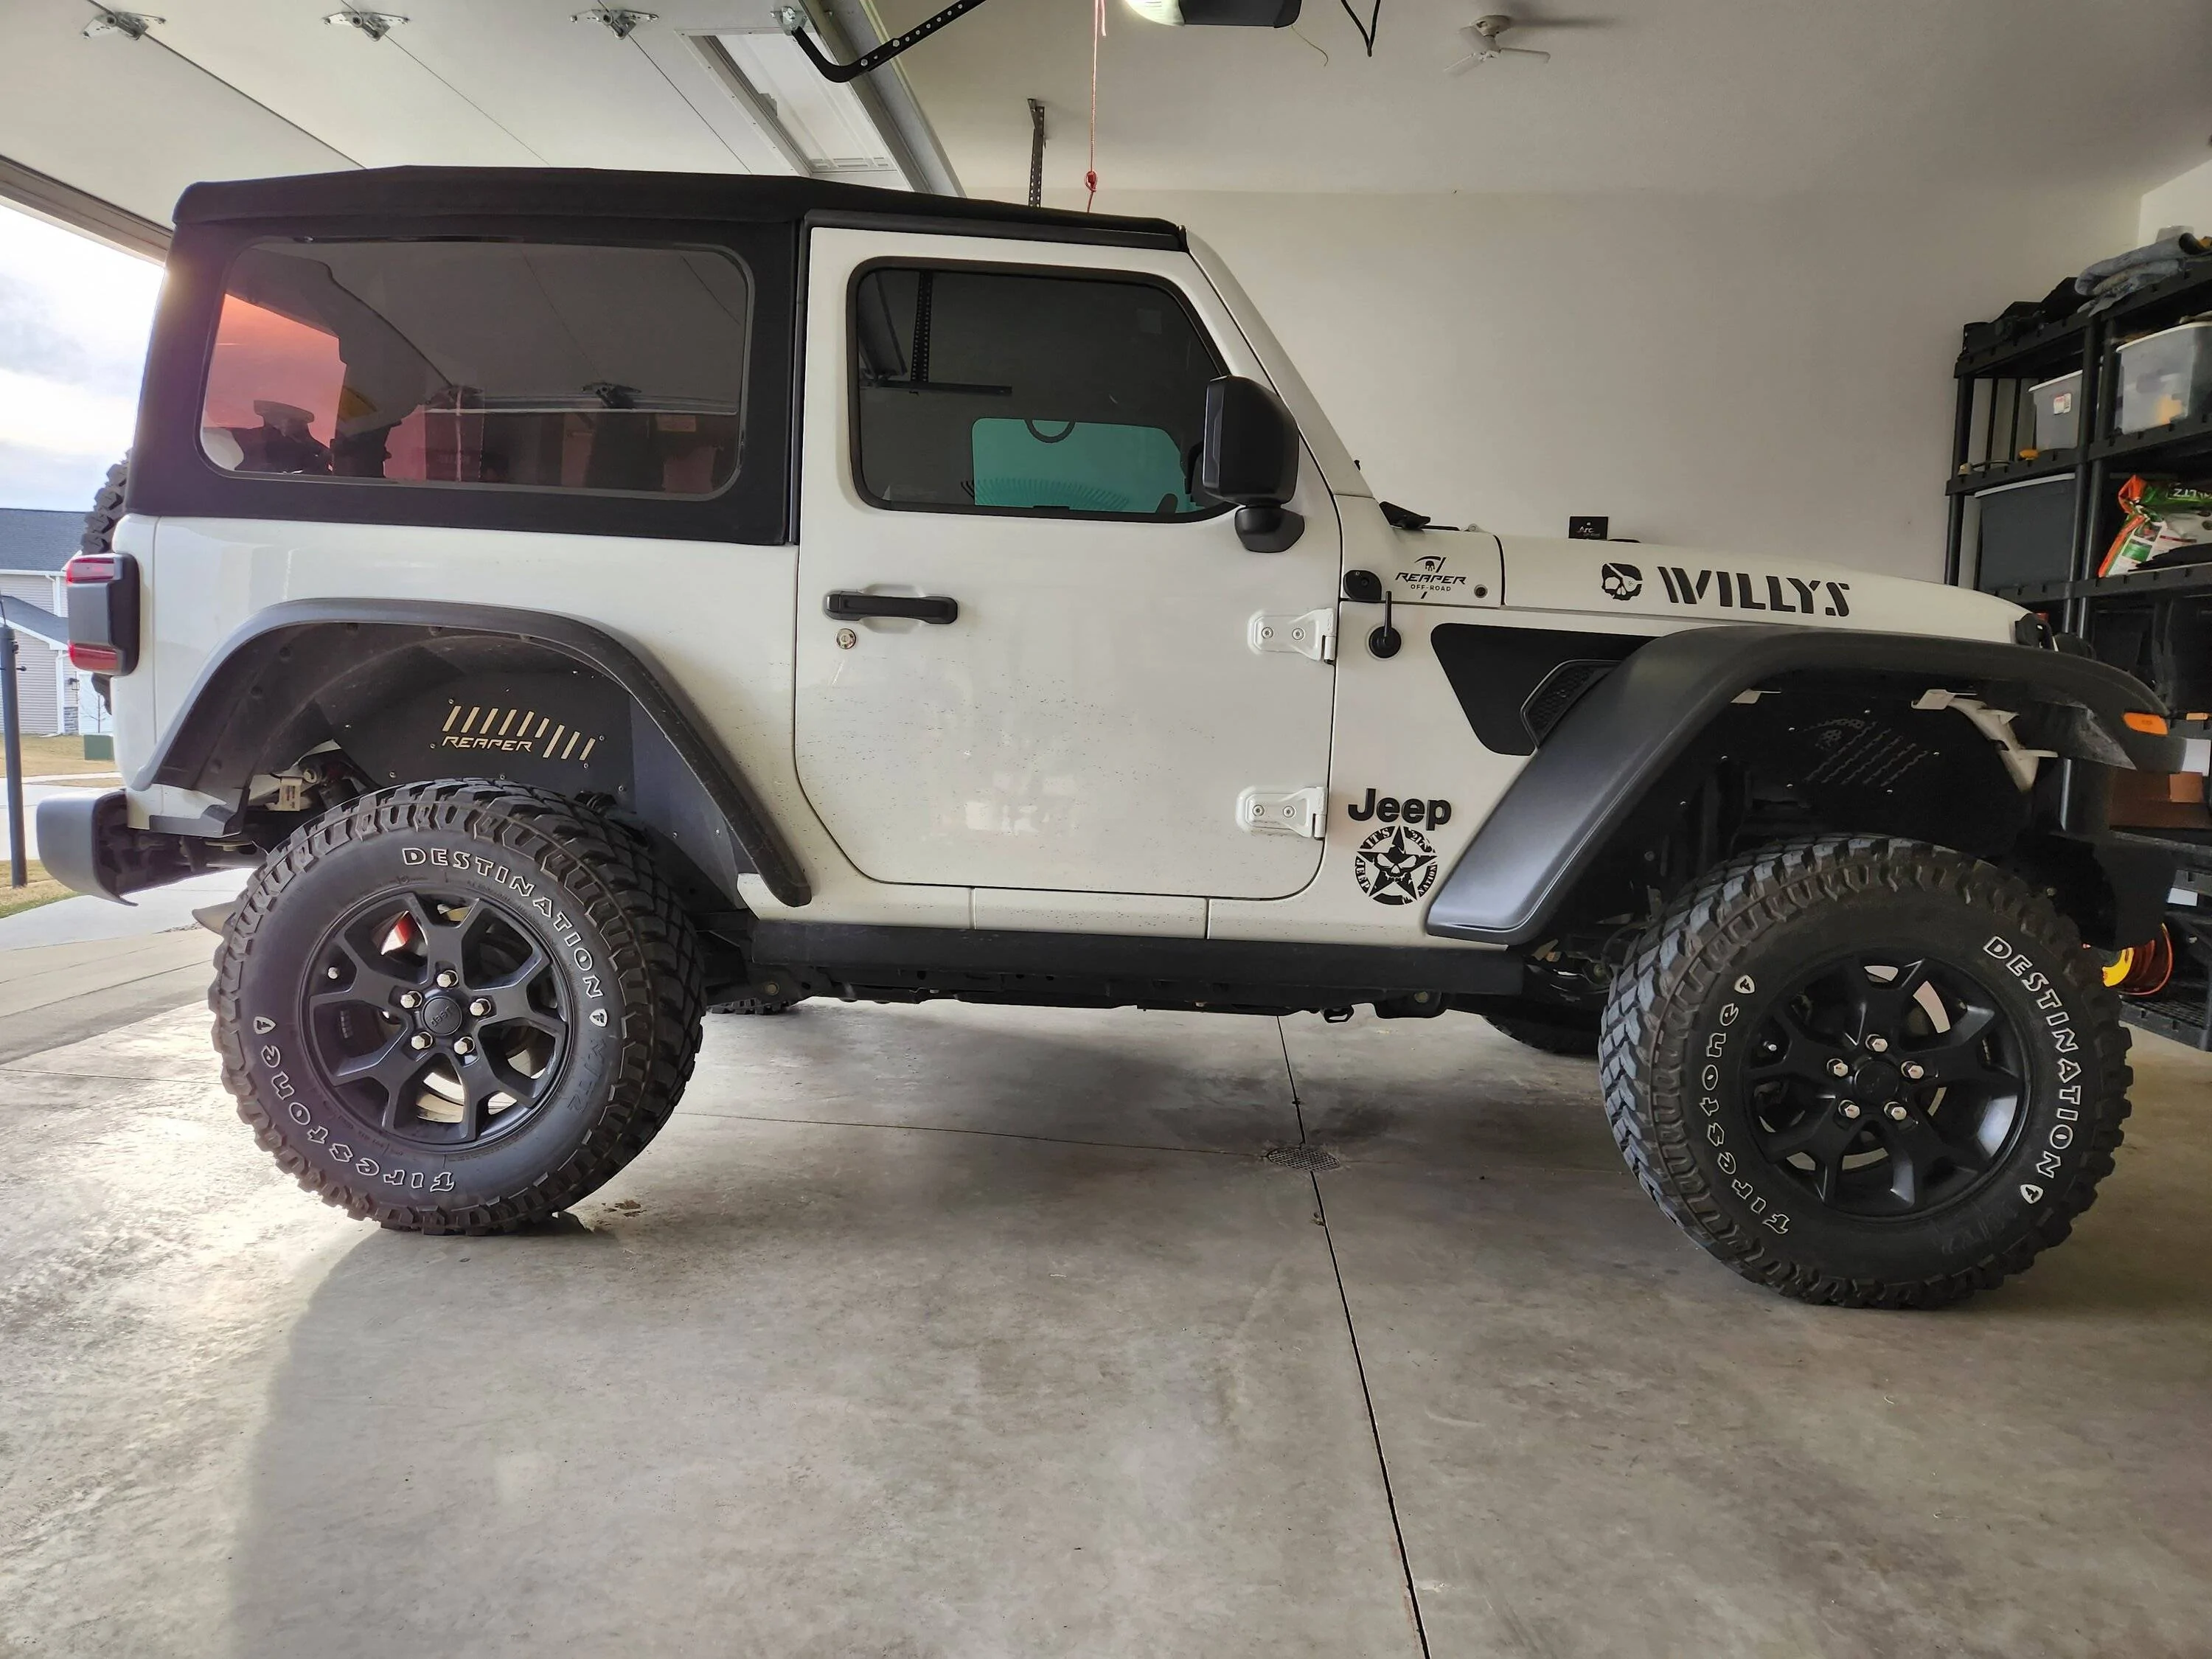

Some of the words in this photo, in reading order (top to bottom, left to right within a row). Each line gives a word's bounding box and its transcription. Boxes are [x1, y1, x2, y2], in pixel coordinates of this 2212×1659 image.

[1395, 572, 1467, 585] REAPER
[1657, 566, 1850, 616] WILLYS
[442, 736, 532, 752] REAPER
[1348, 788, 1452, 830] Jeep
[1365, 827, 1390, 846] IT'S
[1356, 859, 1370, 889] JEEP
[1418, 864, 1437, 894] NATION
[402, 847, 604, 998] DESTINATION
[1983, 936, 2081, 1179] DESTINATION
